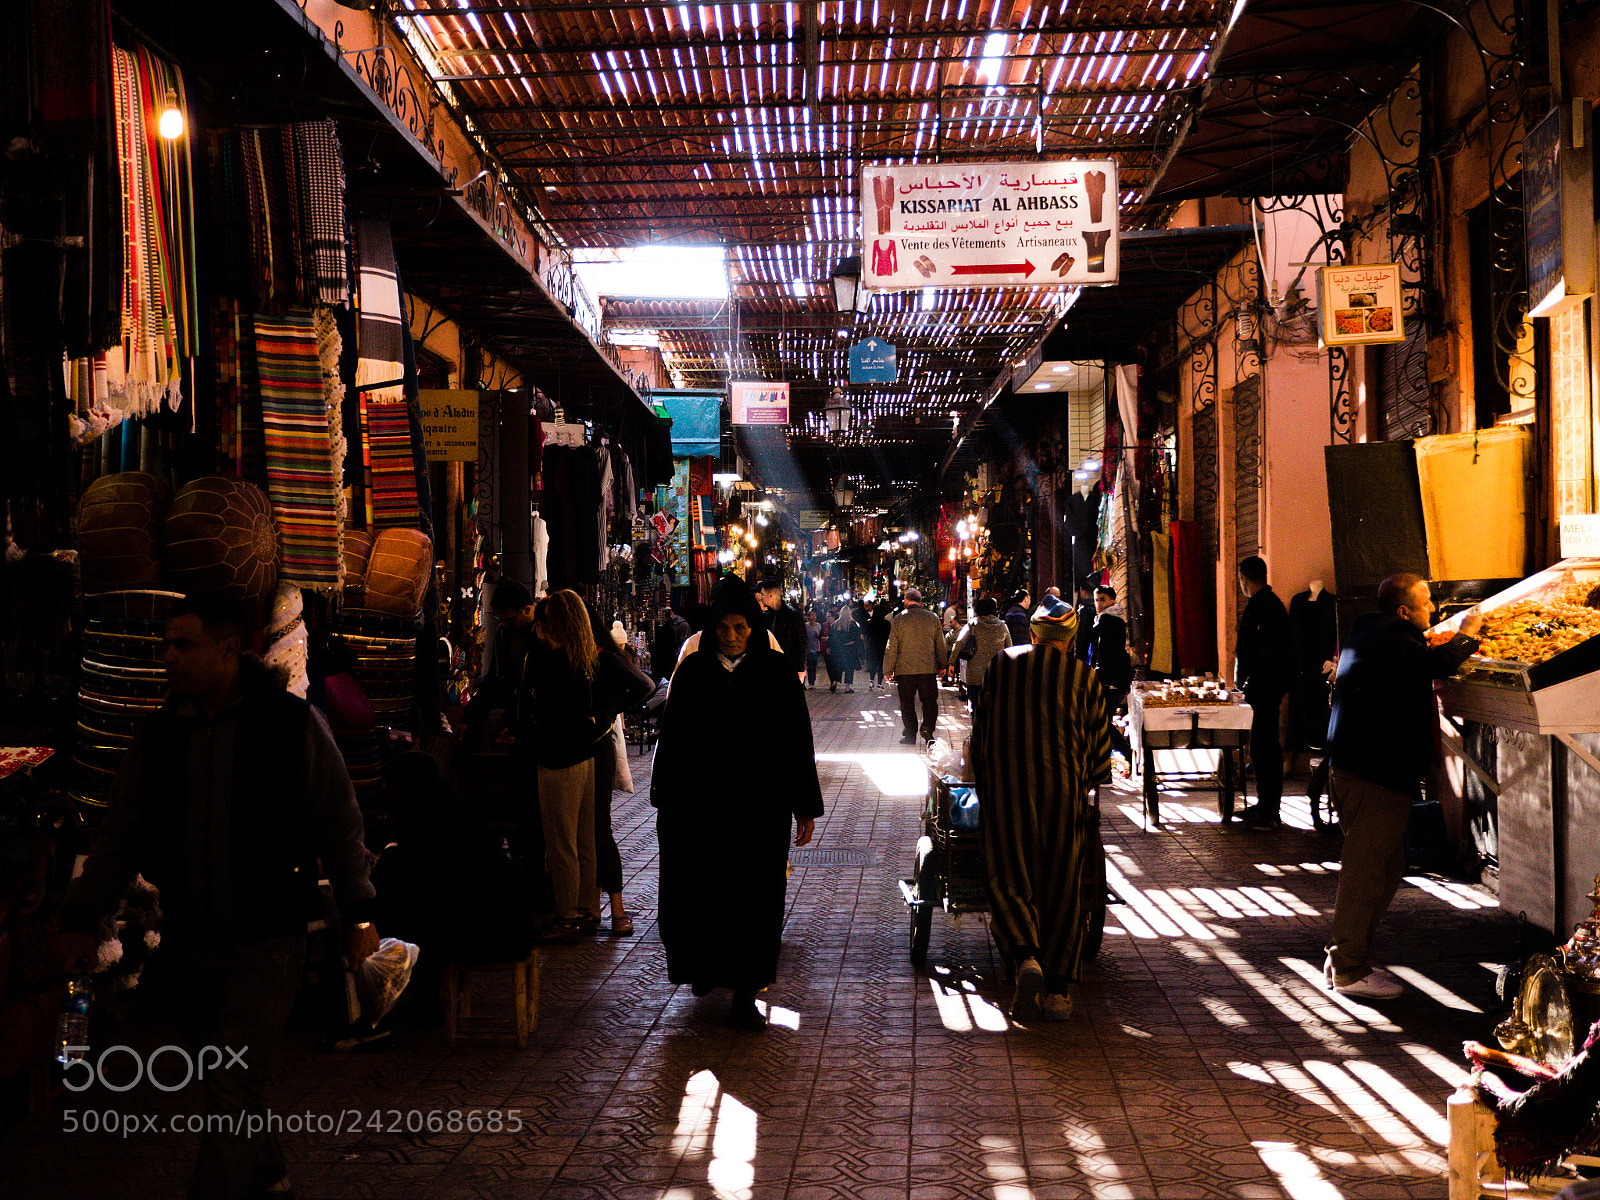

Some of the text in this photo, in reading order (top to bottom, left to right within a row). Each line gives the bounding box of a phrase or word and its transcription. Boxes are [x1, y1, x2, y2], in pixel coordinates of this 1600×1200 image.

[899, 172, 1079, 195] قيسارية الأحباس
[900, 195, 1079, 214] KISSARIAT AL AHBASS
[903, 216, 1073, 235] بيع جميع أنواع الملابس التقليدية
[901, 235, 1078, 251] Vente des Vêtements Artisaneaux
